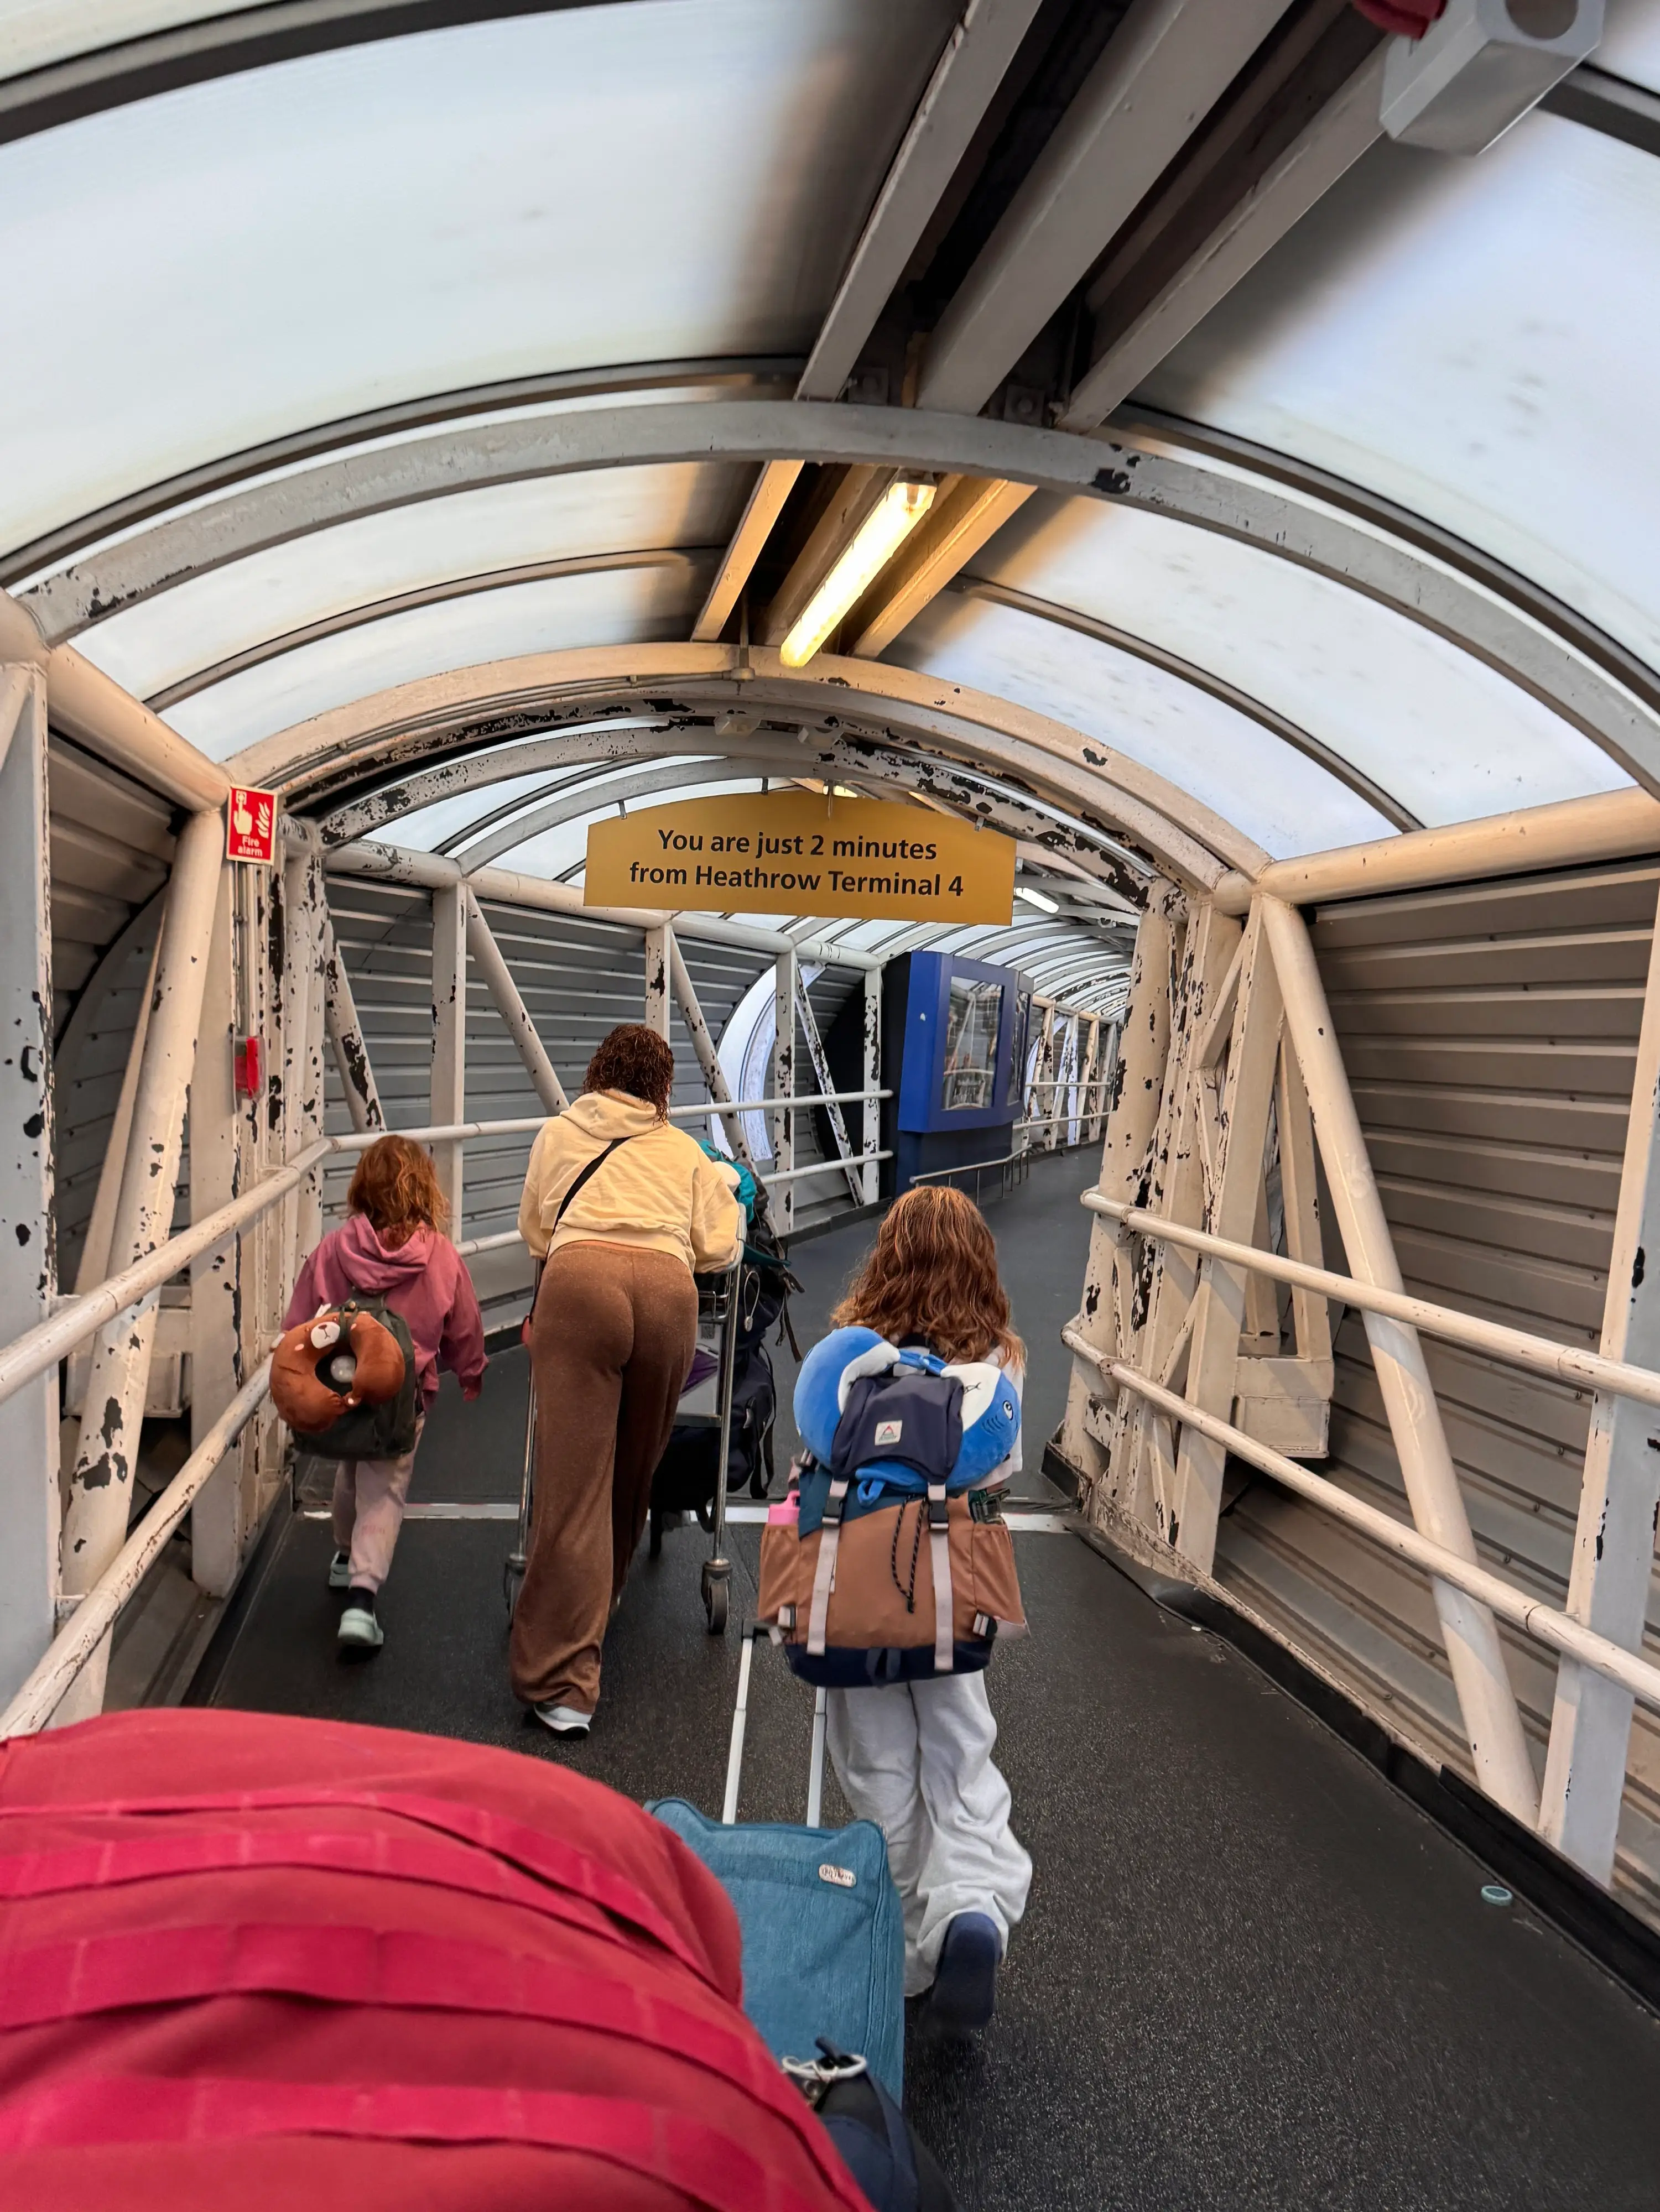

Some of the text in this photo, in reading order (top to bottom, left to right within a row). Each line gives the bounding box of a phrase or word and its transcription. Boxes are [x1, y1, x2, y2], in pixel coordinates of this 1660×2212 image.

[238, 845, 263, 857] alarm
[242, 836, 259, 847] Fire
[658, 829, 937, 860] You are just 2 minutes
[629, 862, 964, 896] from Heathrow Terminal 4
